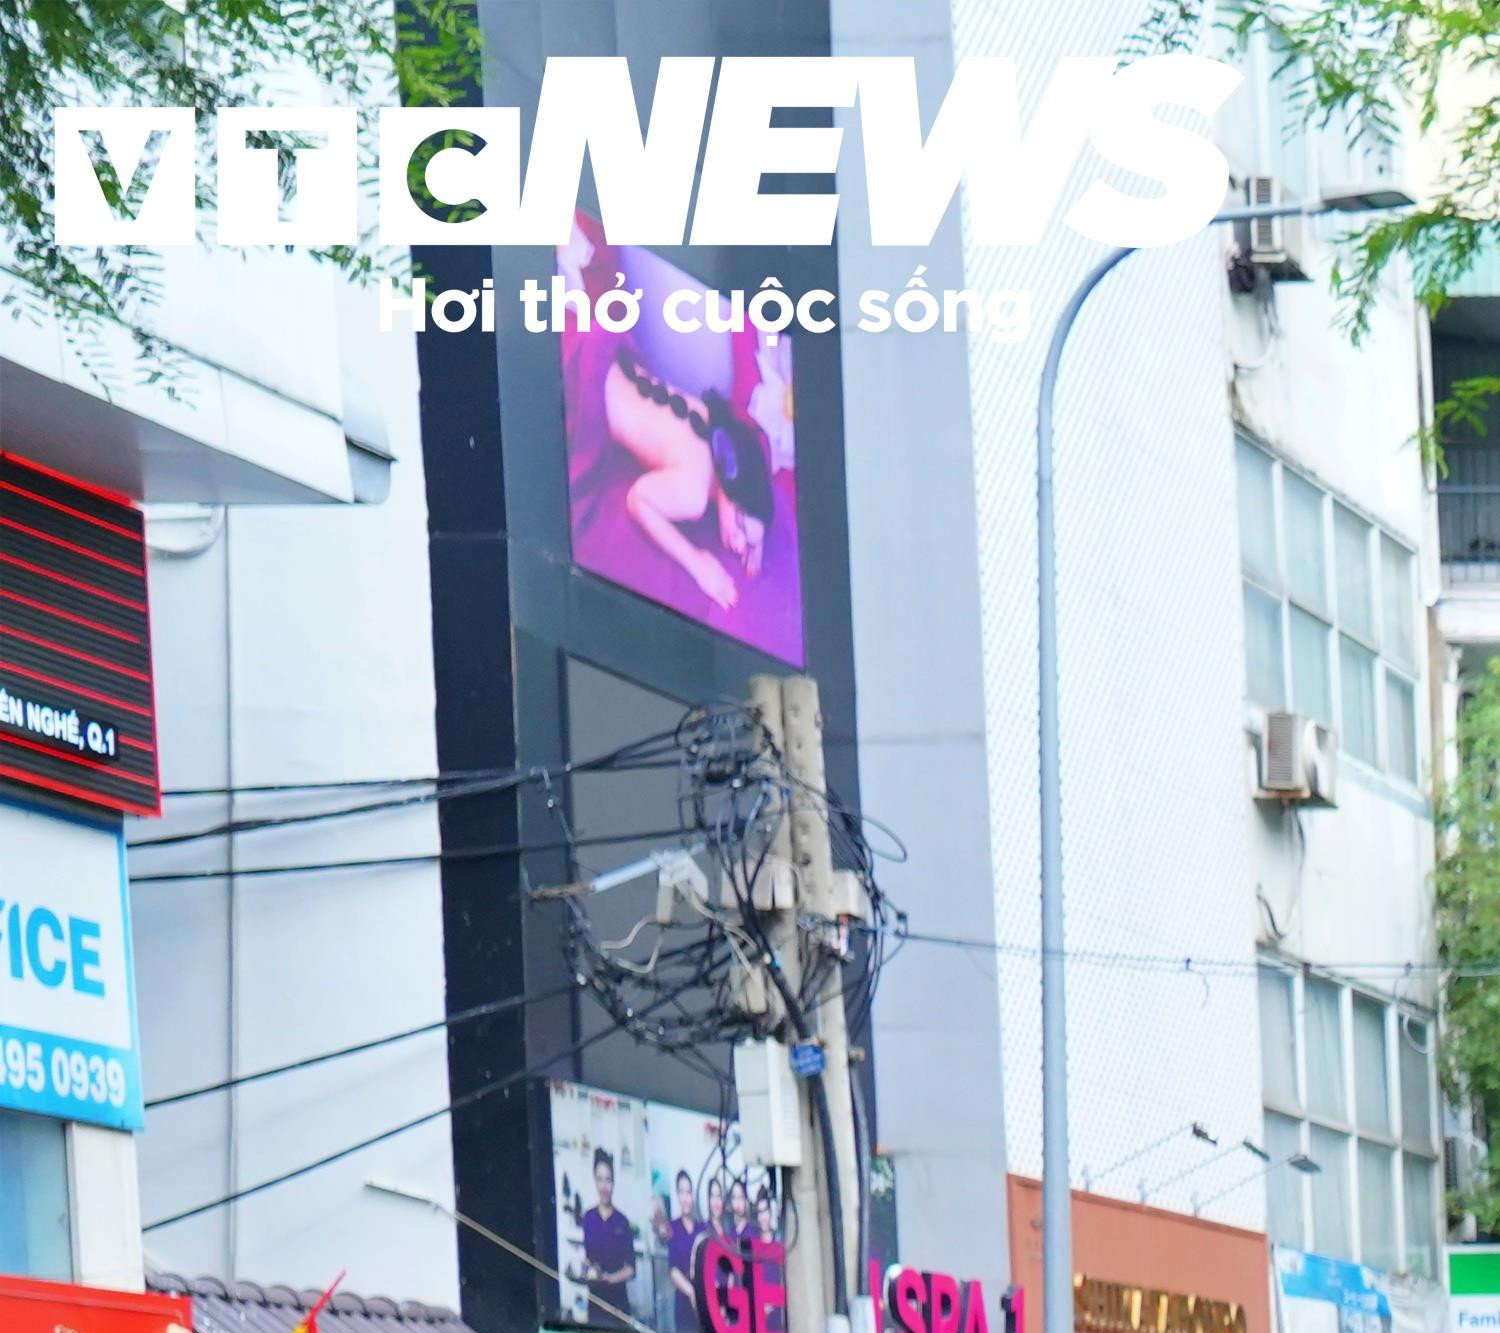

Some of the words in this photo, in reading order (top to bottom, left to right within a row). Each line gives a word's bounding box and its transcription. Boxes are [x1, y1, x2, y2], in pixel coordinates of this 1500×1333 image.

[87, 722, 115, 756] Q.1
[0, 898, 105, 998] ICE
[51, 1046, 125, 1109] 0939
